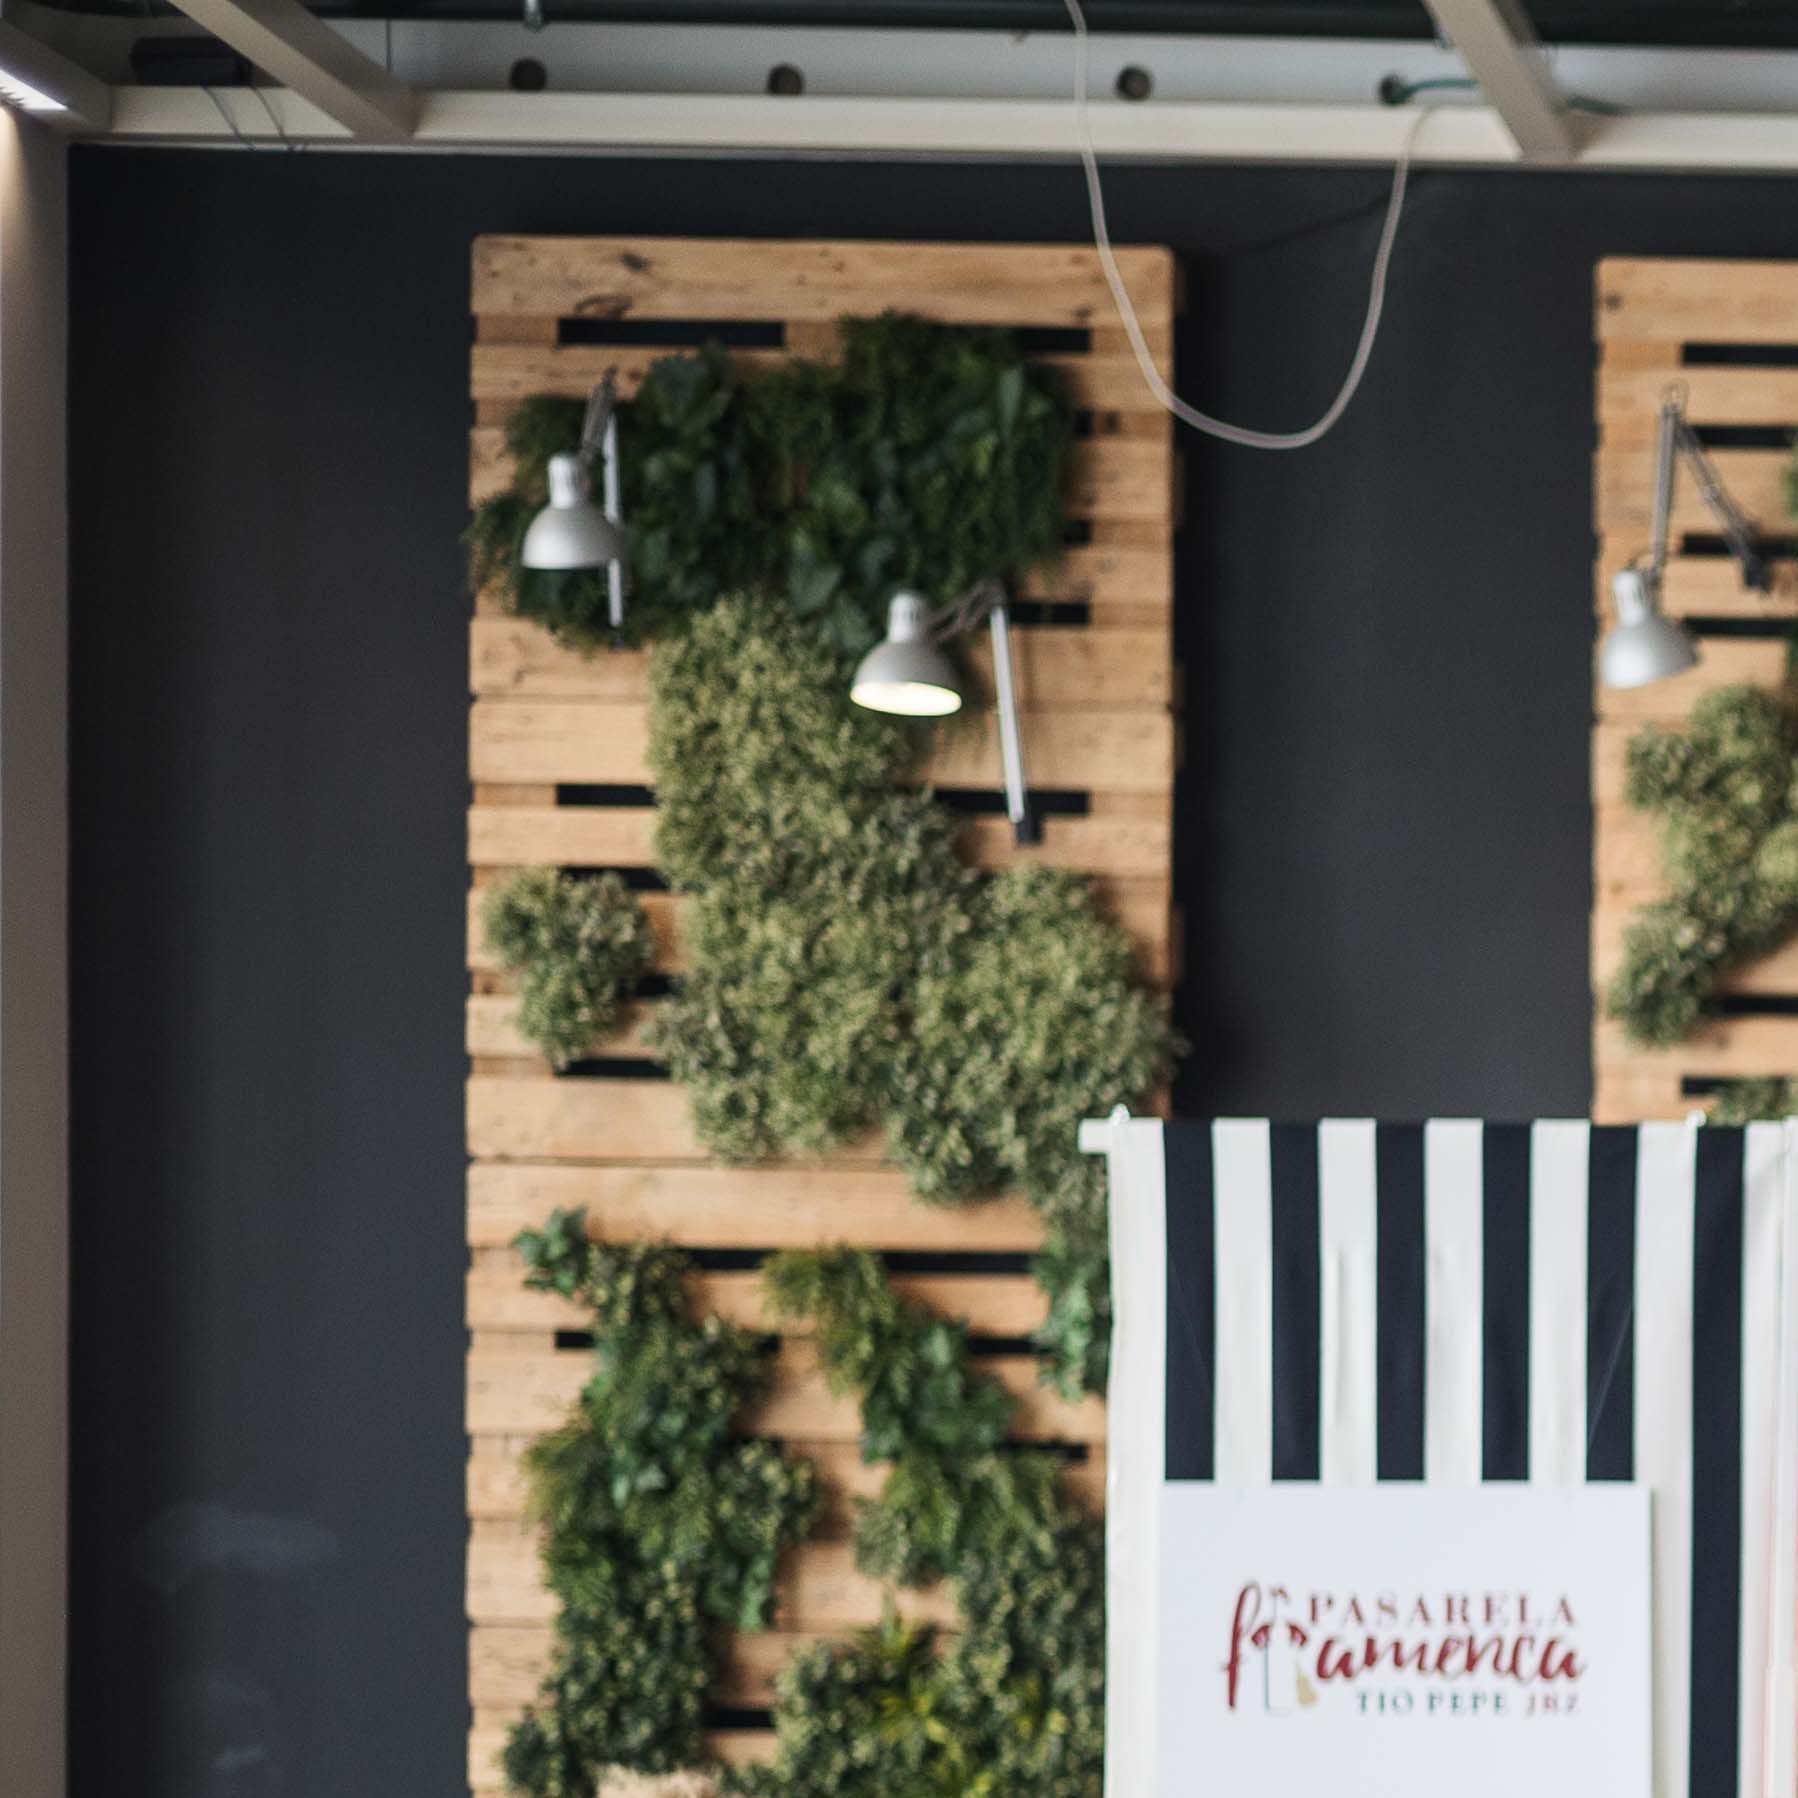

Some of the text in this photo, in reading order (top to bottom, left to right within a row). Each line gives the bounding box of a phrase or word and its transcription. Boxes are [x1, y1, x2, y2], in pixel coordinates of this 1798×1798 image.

[1307, 1593, 1576, 1628] PASARELA
[1356, 1690, 1415, 1714] TIO
[1427, 1690, 1510, 1714] PEPE
